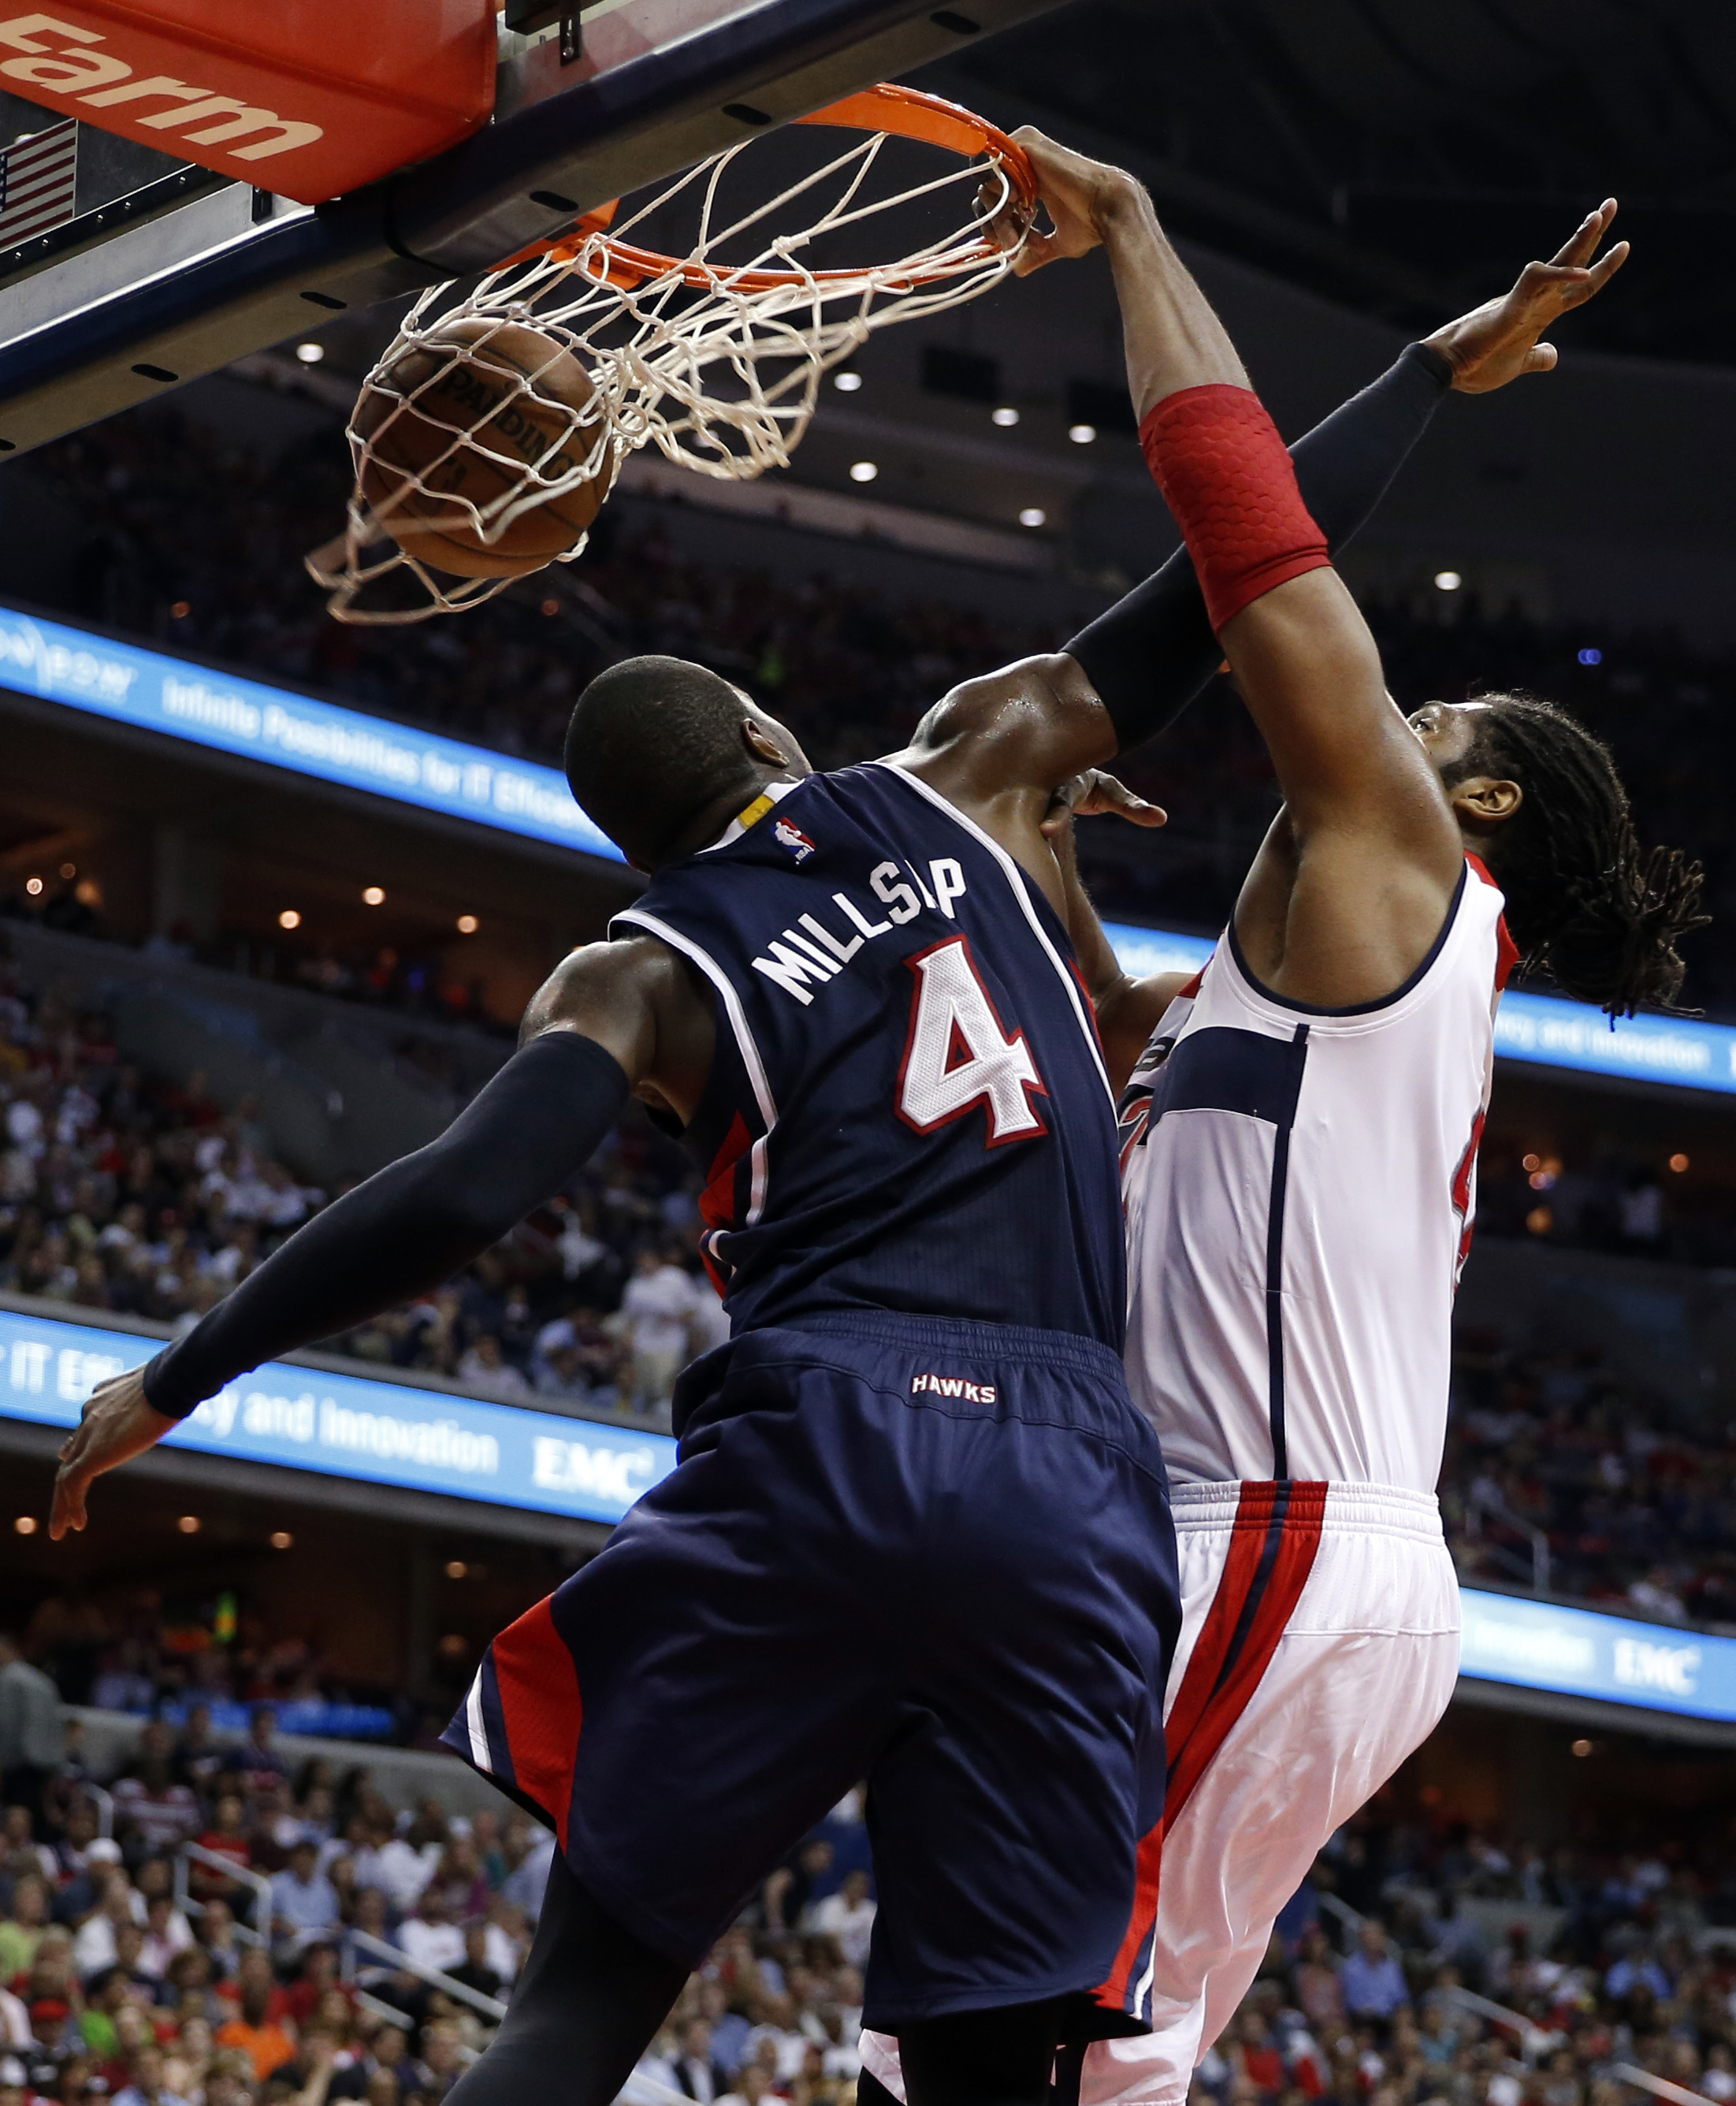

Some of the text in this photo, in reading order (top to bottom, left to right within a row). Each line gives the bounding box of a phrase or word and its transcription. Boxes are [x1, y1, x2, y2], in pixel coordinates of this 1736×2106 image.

[0, 13, 323, 161] Farm
[162, 675, 261, 740] Infinite
[262, 705, 420, 785] Possibilities
[422, 751, 461, 794] for
[463, 762, 493, 805] IT
[894, 934, 1049, 1149] 4
[10, 1340, 53, 1393] IT
[912, 1373, 996, 1404] HAWKS
[242, 1392, 314, 1443] and
[319, 1397, 499, 1476] Innovation
